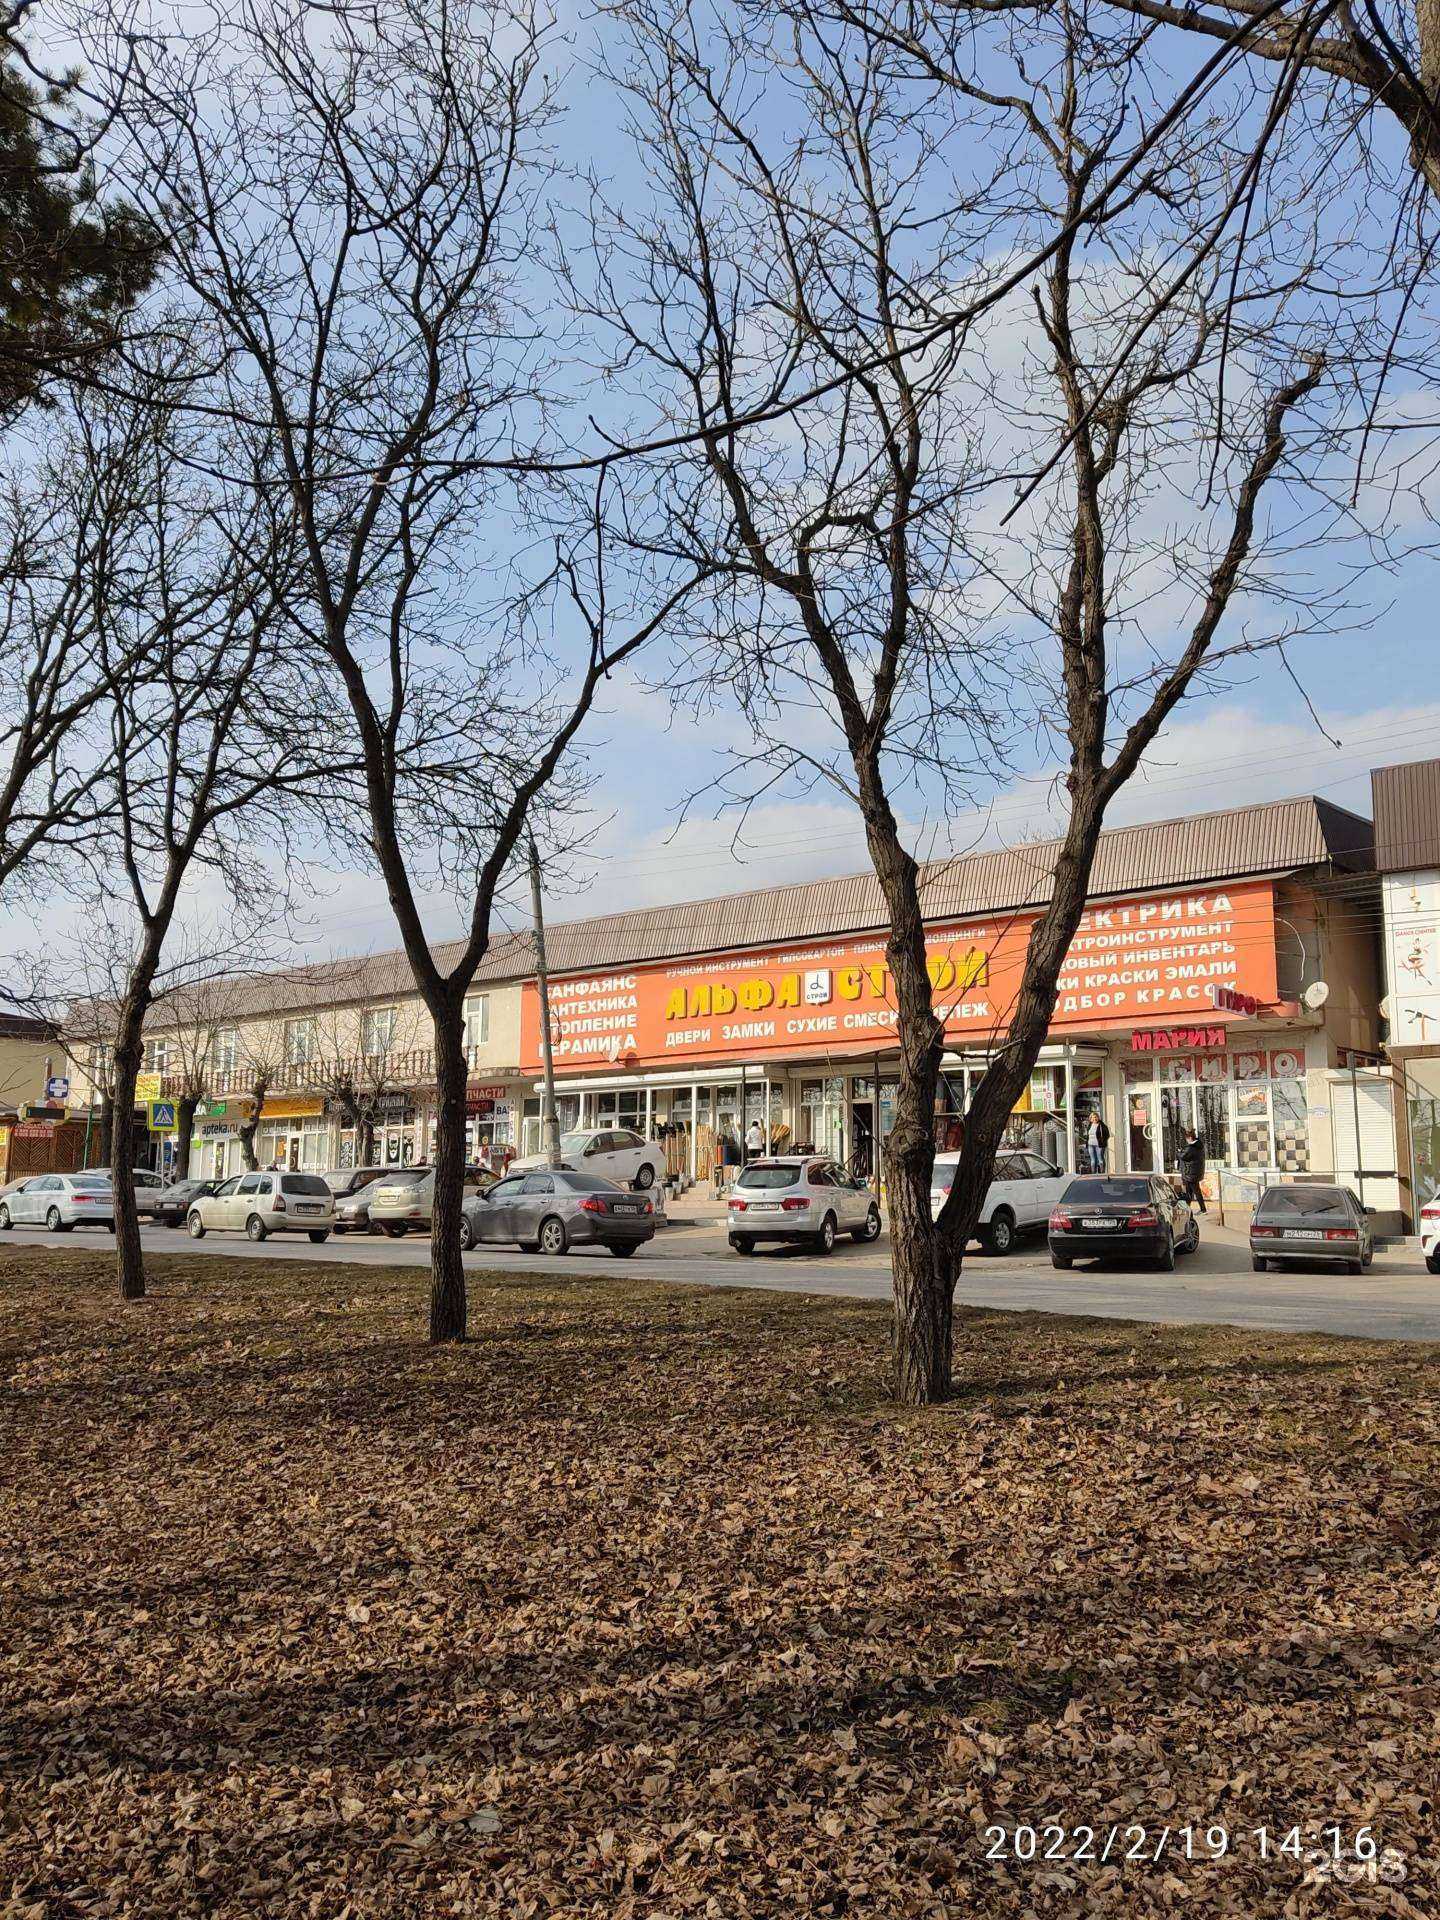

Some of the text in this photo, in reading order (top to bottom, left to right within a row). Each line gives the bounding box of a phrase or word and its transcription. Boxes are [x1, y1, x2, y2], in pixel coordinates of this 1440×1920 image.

[1077, 894, 1233, 932] ЕКТРИКА
[1069, 920, 1234, 951] ТРОИНСТРУМЕНТ
[666, 964, 703, 979] РУЧНОЙ
[705, 957, 769, 974] ИНСТРУМЕНТ
[778, 946, 845, 965] ГИПСОКАРТОН
[1122, 940, 1236, 964] ИНВЕНТАРЬ
[665, 947, 990, 1020] АЛЬФА СТОЙ
[1084, 968, 1160, 988] КРАСКИ
[1166, 960, 1237, 980] ЭМАЛИ
[549, 995, 638, 1017] АНТЕХНИКА
[549, 1013, 637, 1039] ТОПЛЕНИЕ
[666, 1028, 711, 1047] ДВЕРИ
[722, 1021, 775, 1041] ЗАМКИ
[786, 1015, 837, 1034] СУХИЕ
[1131, 1025, 1226, 1051] МАРИЯ
[201, 1121, 238, 1137] apteka.ru
